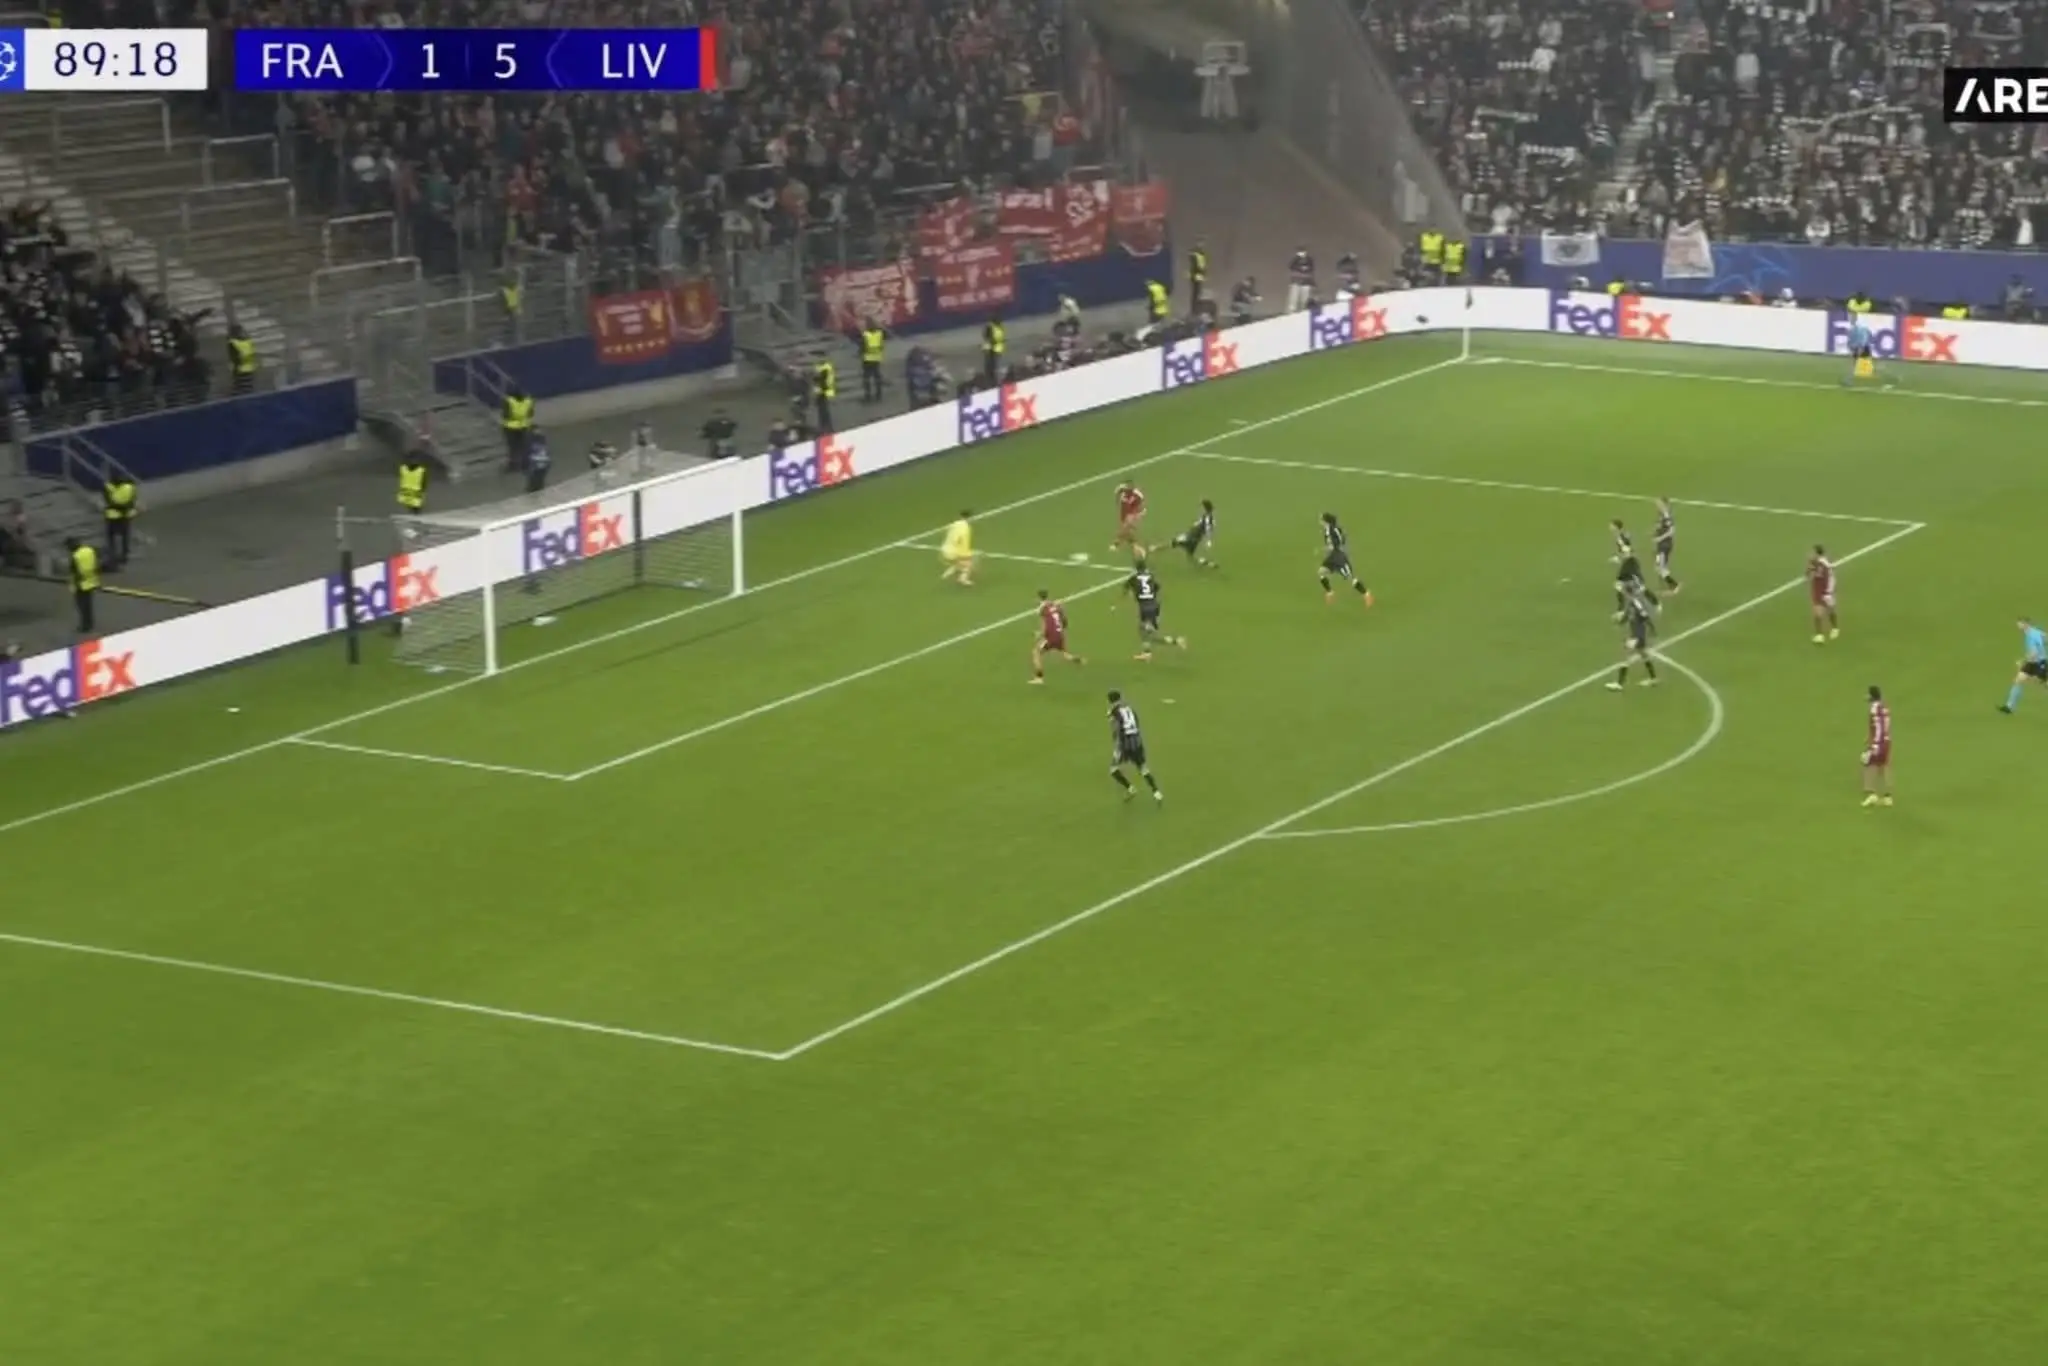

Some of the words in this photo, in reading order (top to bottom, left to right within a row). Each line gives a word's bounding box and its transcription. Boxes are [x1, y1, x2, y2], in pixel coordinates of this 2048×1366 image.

[1310, 293, 1387, 349] FedEx
[1549, 292, 1671, 340] FedEx
[1827, 308, 1958, 362] FdEx
[1162, 328, 1238, 390] FedEx
[958, 382, 1037, 444] FedEx
[770, 432, 855, 499] FedEx
[523, 503, 623, 573] FedEx
[0, 638, 137, 723] FedEx
